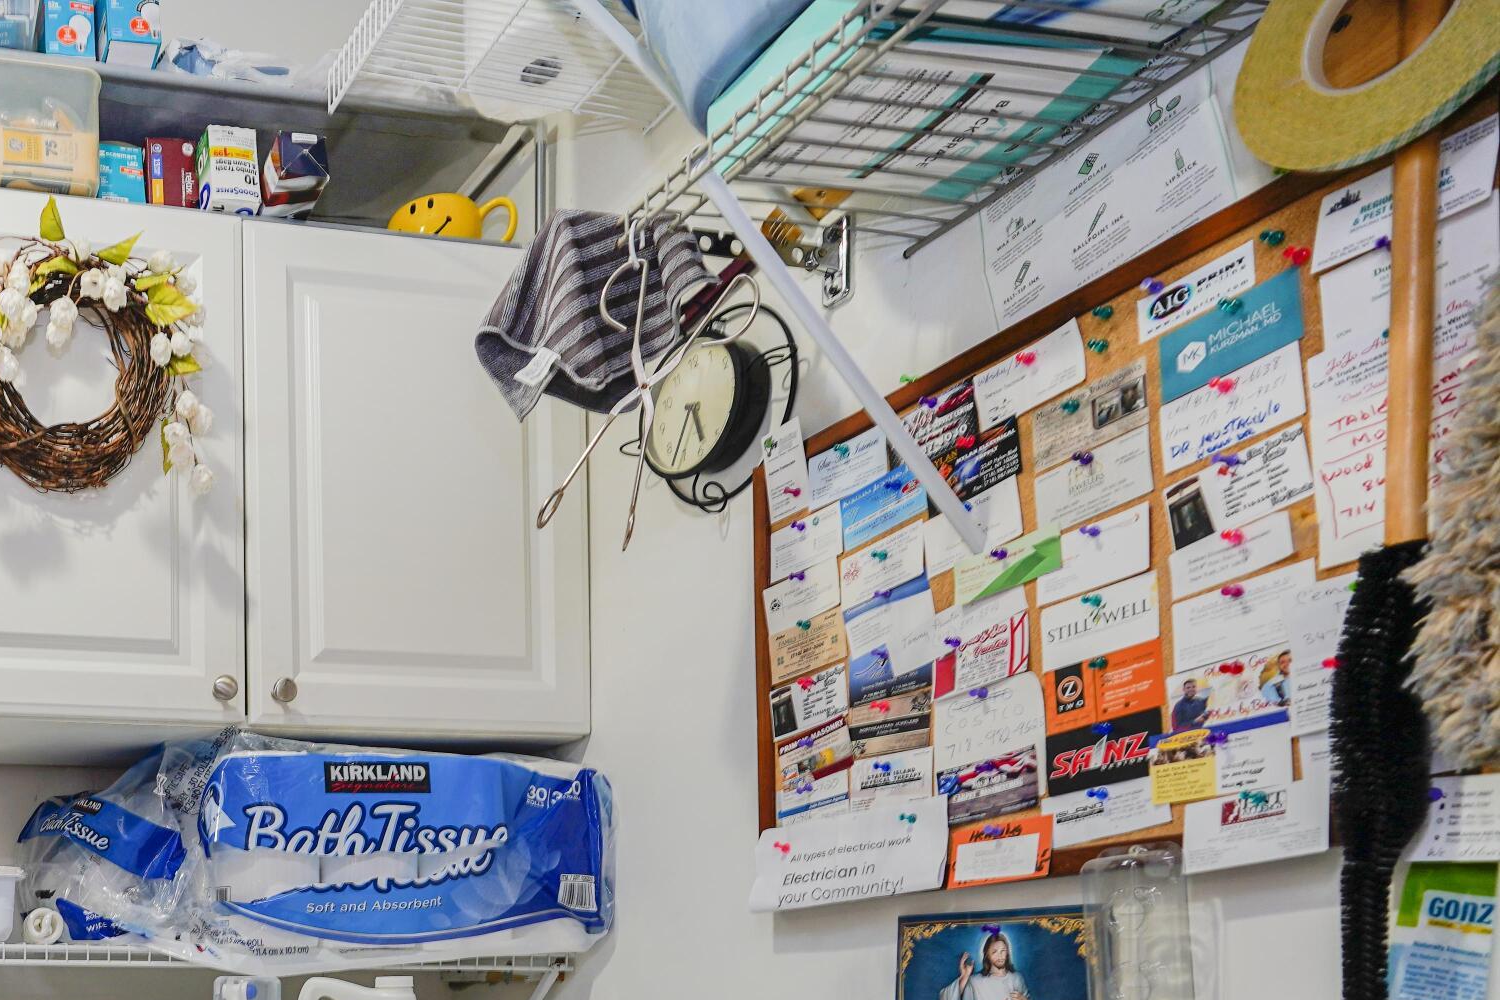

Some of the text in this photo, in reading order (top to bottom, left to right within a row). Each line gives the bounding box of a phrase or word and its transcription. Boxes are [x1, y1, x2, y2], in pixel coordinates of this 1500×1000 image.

[1209, 302, 1281, 342] MICHAEL
[1264, 311, 1283, 328] MD
[809, 718, 845, 742] MASONRY
[329, 764, 427, 782] KIRKLAND
[526, 784, 548, 802] 30
[66, 811, 111, 851] Tissue
[789, 853, 802, 864] All
[803, 849, 828, 864] types
[836, 838, 887, 856] electrical
[887, 834, 912, 849] work
[782, 861, 876, 887] Electrician in
[305, 894, 443, 915] Soft and Absorbent
[777, 876, 904, 908] your Community!
